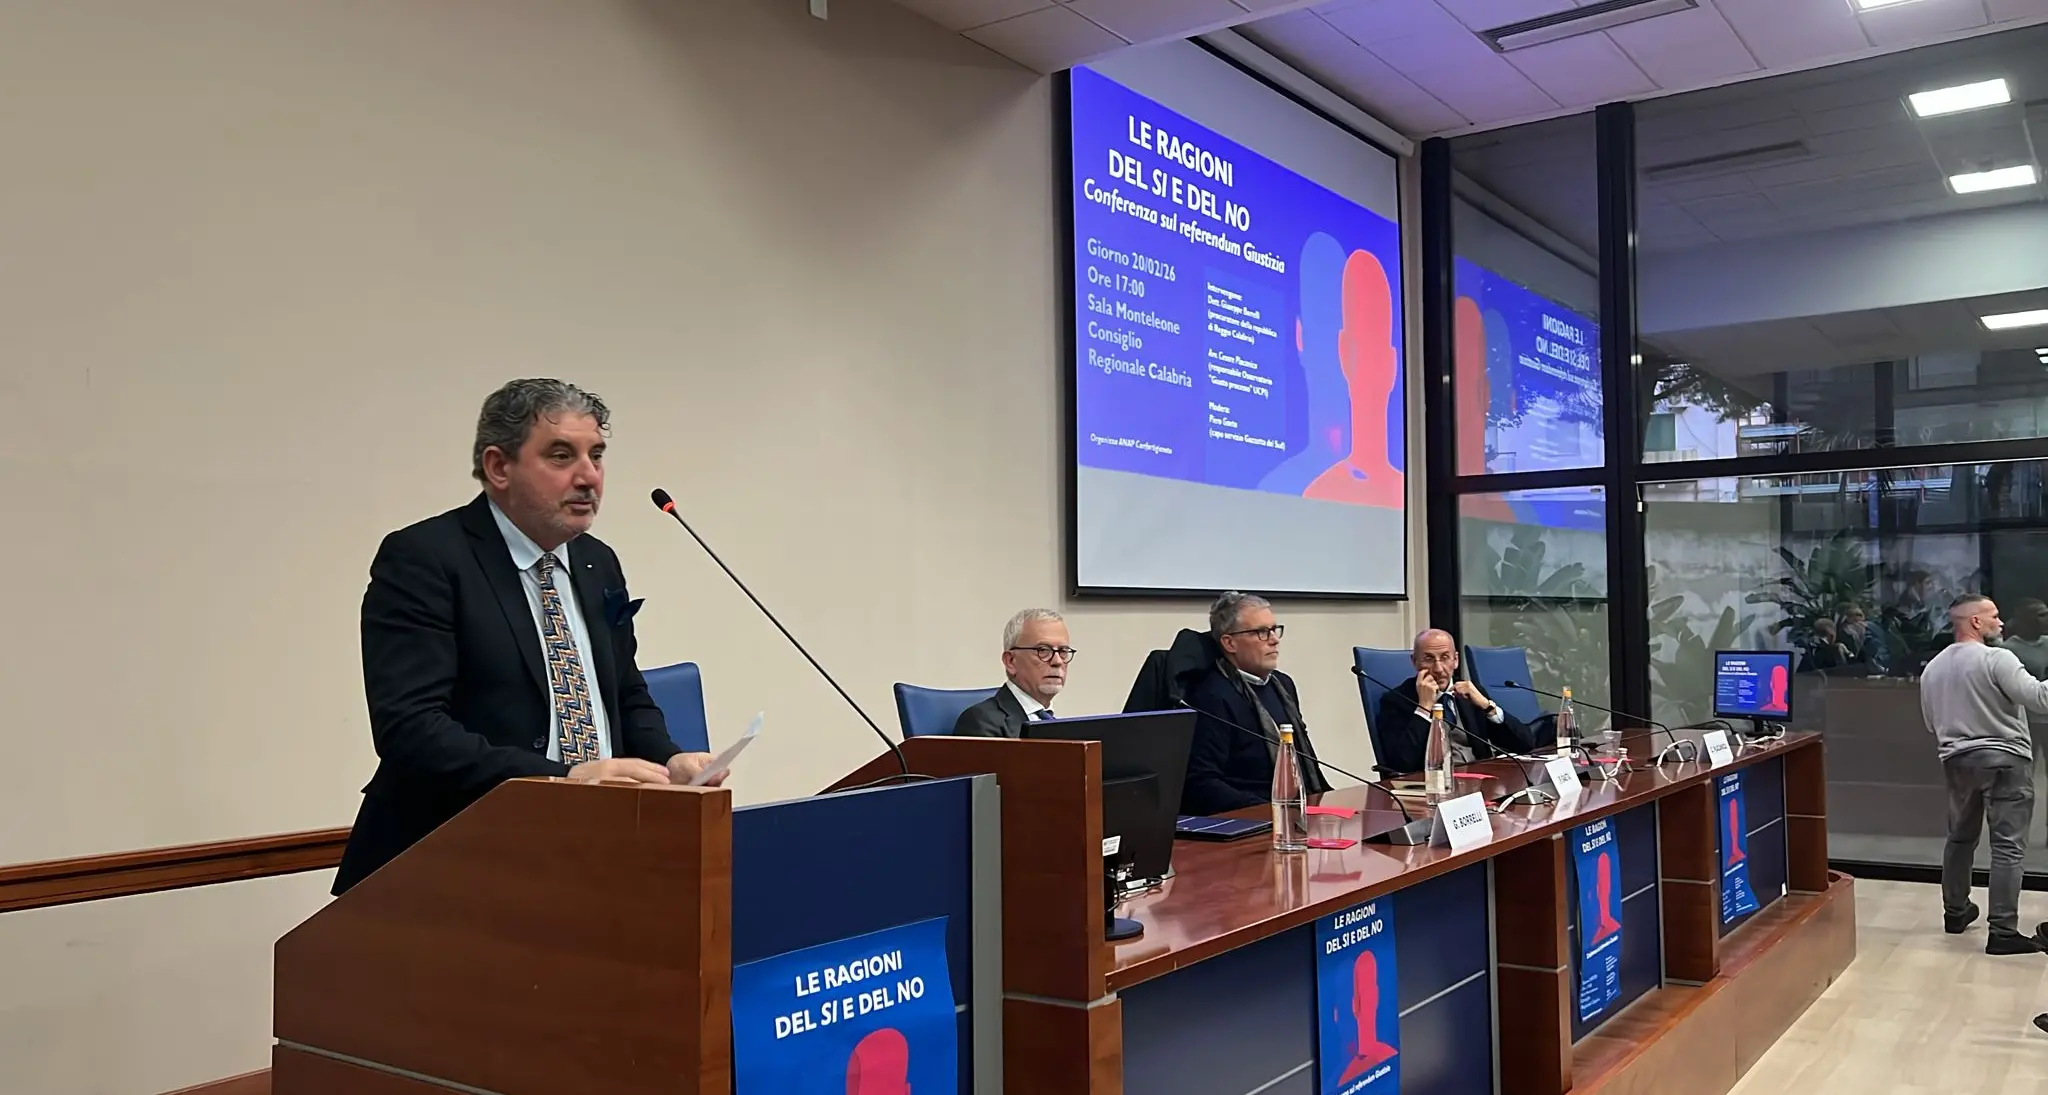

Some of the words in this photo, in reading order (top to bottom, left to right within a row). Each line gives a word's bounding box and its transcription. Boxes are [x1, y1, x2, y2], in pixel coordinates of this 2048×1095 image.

[1129, 115, 1152, 150] LE
[1156, 128, 1233, 187] RAGIONI
[1108, 149, 1148, 190] DEL
[1152, 169, 1168, 198] SI
[1171, 176, 1183, 204] E
[1187, 185, 1221, 221] DEL
[1224, 200, 1250, 232] NO
[1083, 178, 1158, 226] Conferenza
[1160, 212, 1177, 232] sul
[1179, 218, 1241, 256] referendum
[1243, 241, 1285, 273] Giustizia
[1087, 238, 1129, 267] Giorno
[1132, 252, 1176, 282] 20/02/26
[1088, 266, 1111, 288] Ore
[1116, 273, 1145, 298] 17:00
[1088, 293, 1113, 316] Sala
[1116, 301, 1180, 335] Monteleone
[1088, 321, 1142, 351] Consiglio
[1088, 348, 1146, 376] Regionale
[1148, 362, 1192, 388] Calabria
[1326, 938, 1342, 955] DEL
[1350, 931, 1356, 945] E
[1356, 925, 1371, 942] DEL
[1371, 919, 1384, 936] NO
[1334, 917, 1345, 930] LE
[1345, 903, 1376, 925] RAGIONI
[796, 972, 820, 997] LE
[824, 950, 903, 989] RAGIONI
[775, 1010, 817, 1039] DEL
[821, 1000, 837, 1026] SI
[842, 997, 854, 1020] E
[859, 987, 894, 1015] DEL
[897, 977, 925, 1003] NO
